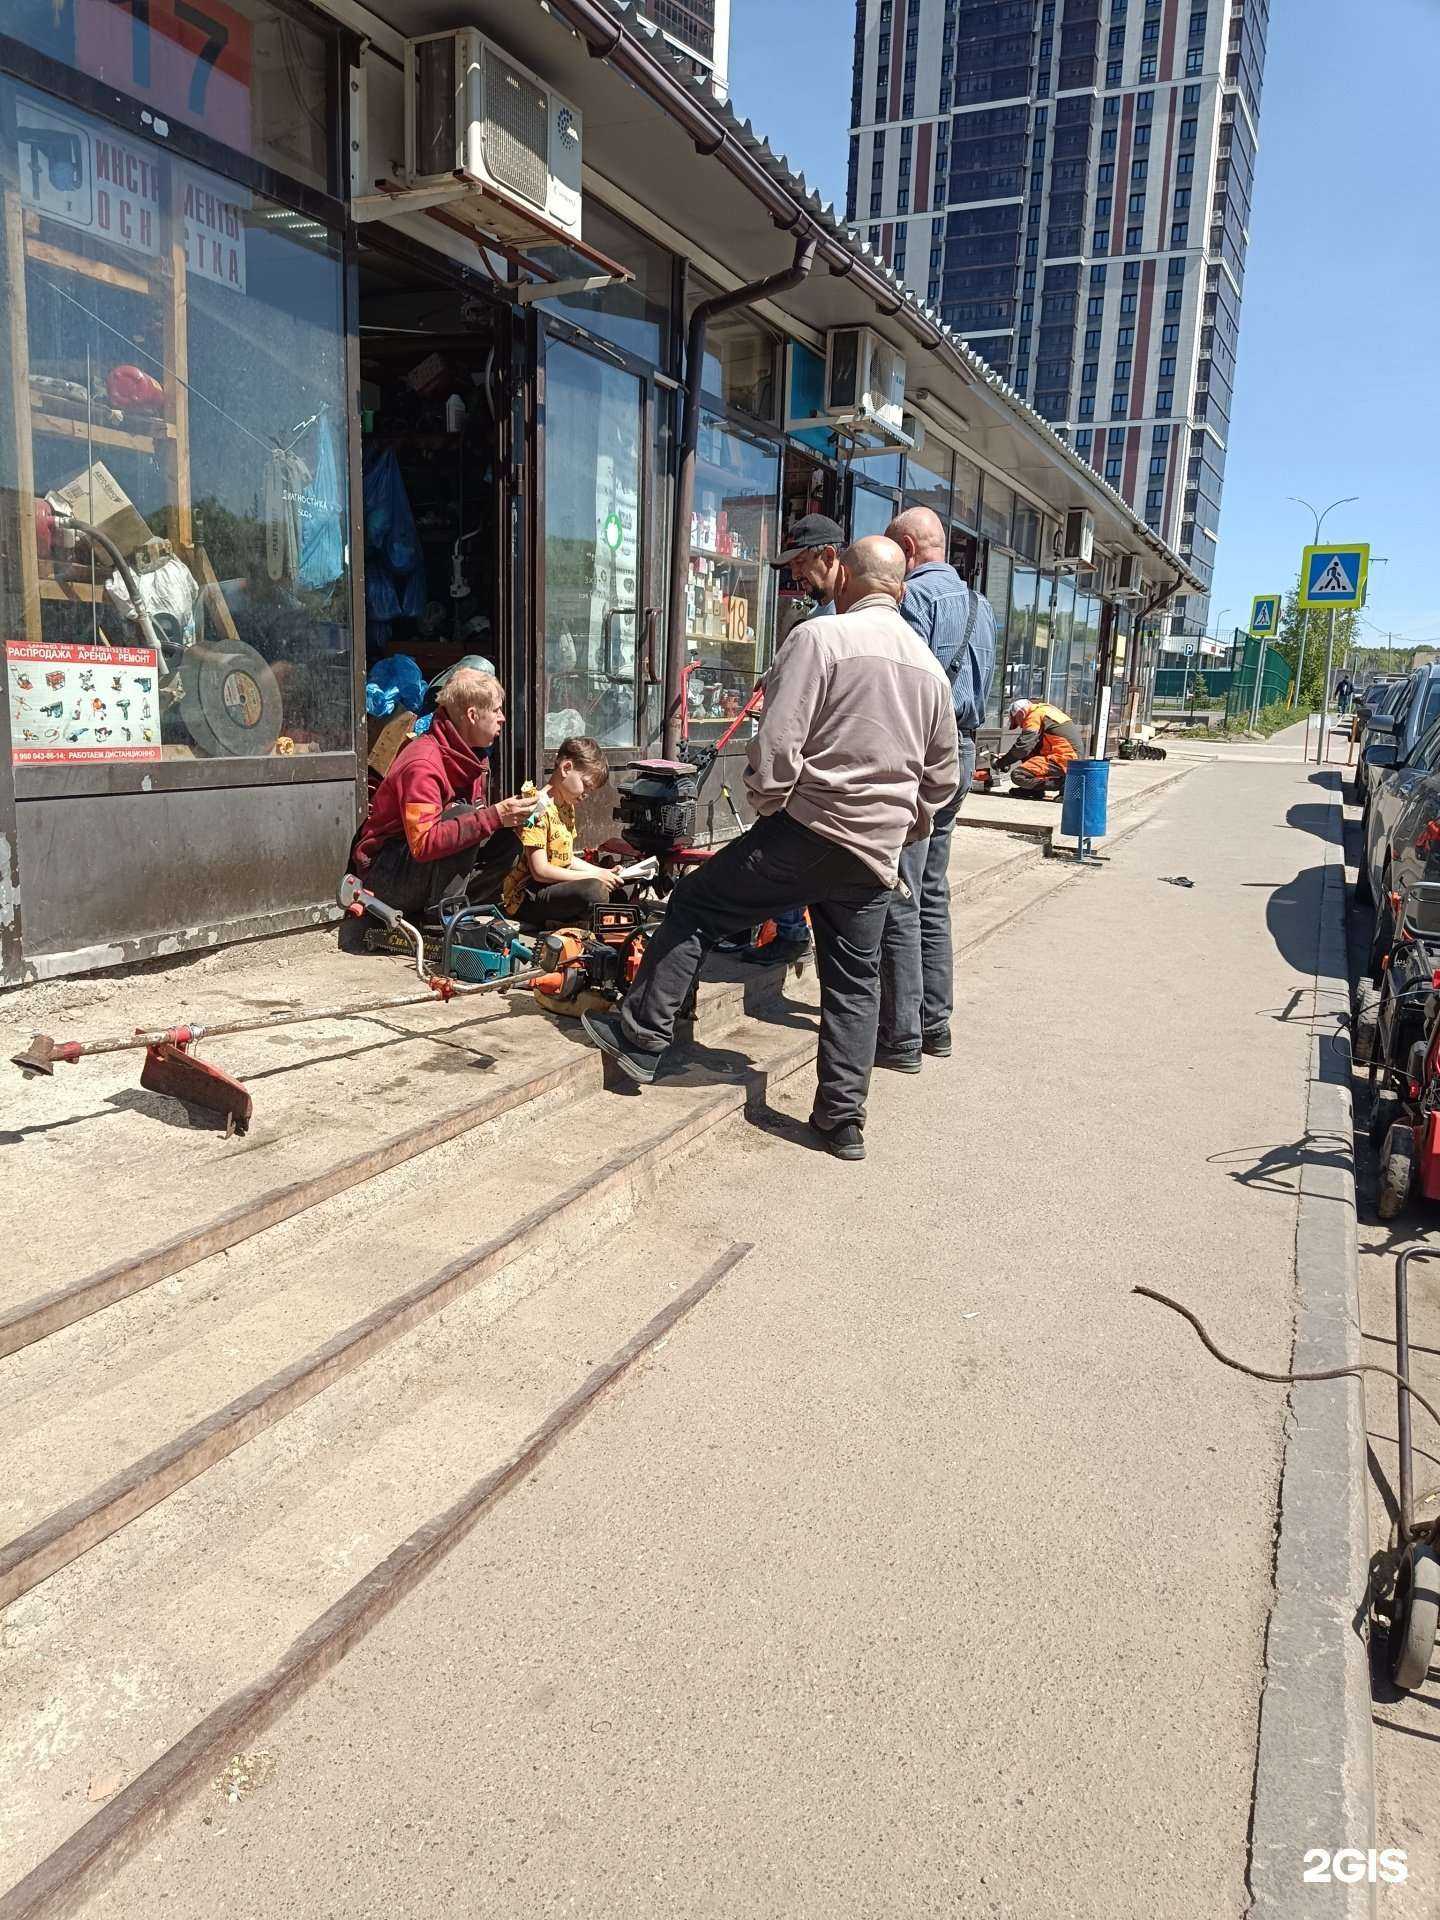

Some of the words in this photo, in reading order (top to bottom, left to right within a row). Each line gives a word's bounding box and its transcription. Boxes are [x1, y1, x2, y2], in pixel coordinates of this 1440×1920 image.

[118, 0, 230, 116] 17
[729, 601, 747, 641] 18
[8, 647, 71, 660] РАСПРОДАЖА
[78, 649, 113, 662] АРЕНДА
[118, 652, 151, 664] РЕМОНТ
[68, 751, 104, 760] РАБОТАЕМ
